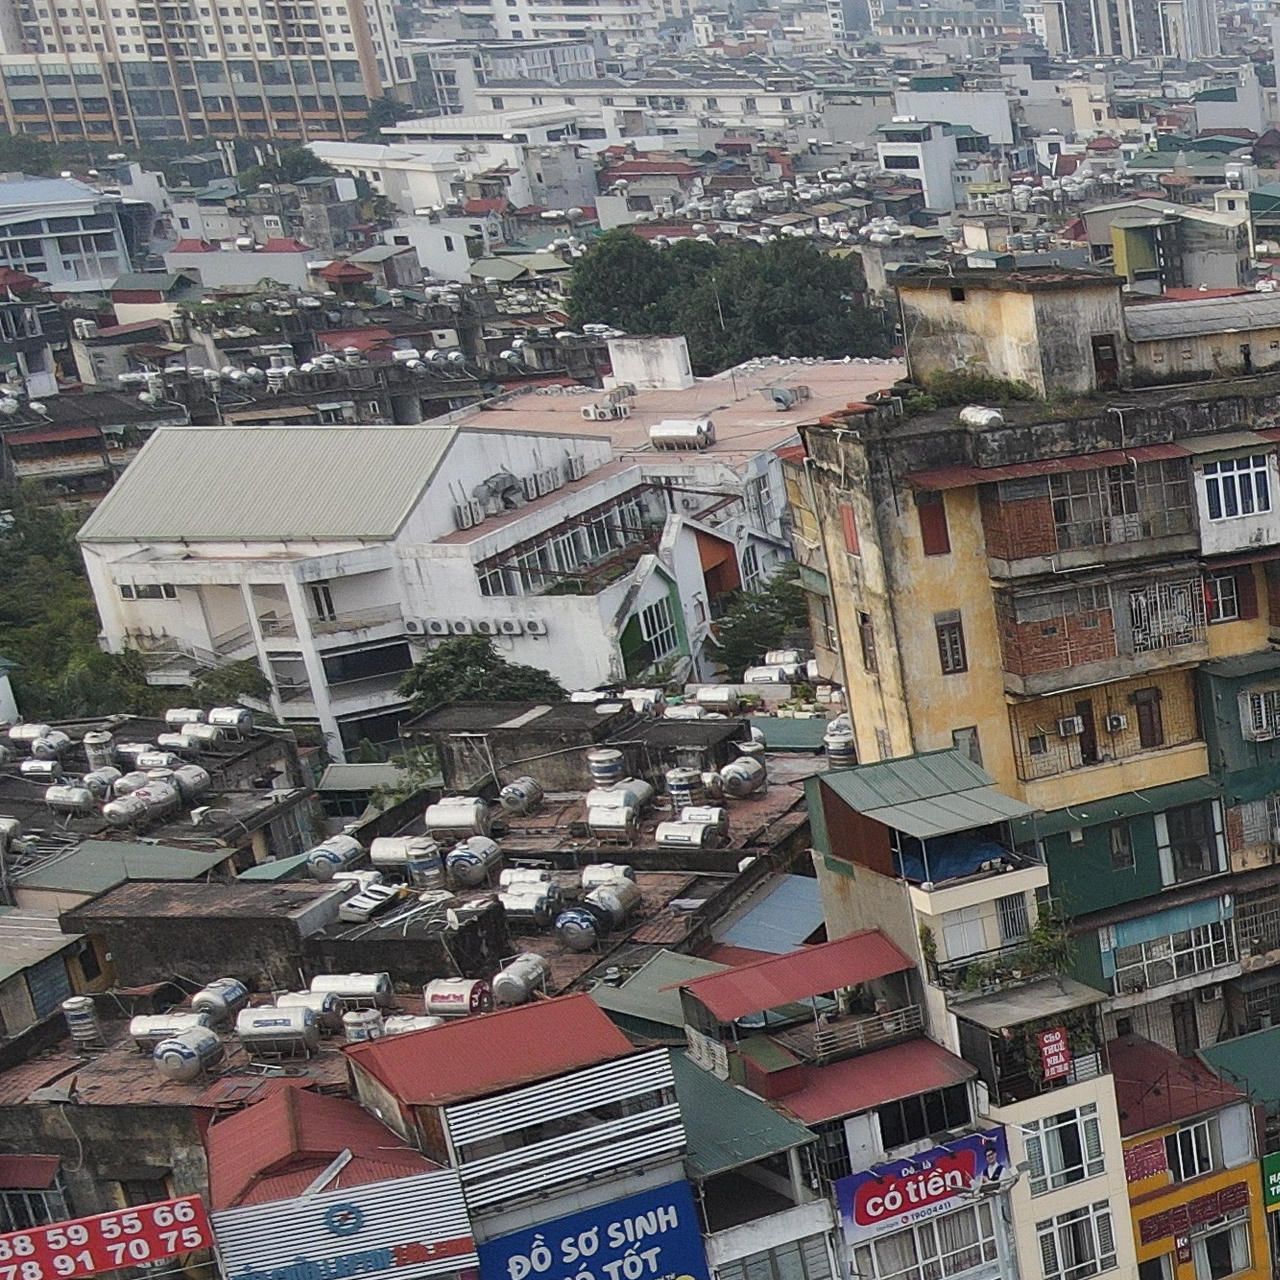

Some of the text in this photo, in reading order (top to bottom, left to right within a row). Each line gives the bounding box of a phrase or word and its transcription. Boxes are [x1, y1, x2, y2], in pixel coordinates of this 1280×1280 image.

[865, 1167, 964, 1217] có tiền
[46, 1224, 90, 1250] 59
[100, 1212, 144, 1239] 55
[152, 1200, 196, 1228] 66
[560, 1225, 600, 1264] SƠ
[606, 1205, 679, 1249] SINH
[53, 1249, 96, 1276] 91
[106, 1238, 150, 1266] 70
[158, 1225, 203, 1253] 75
